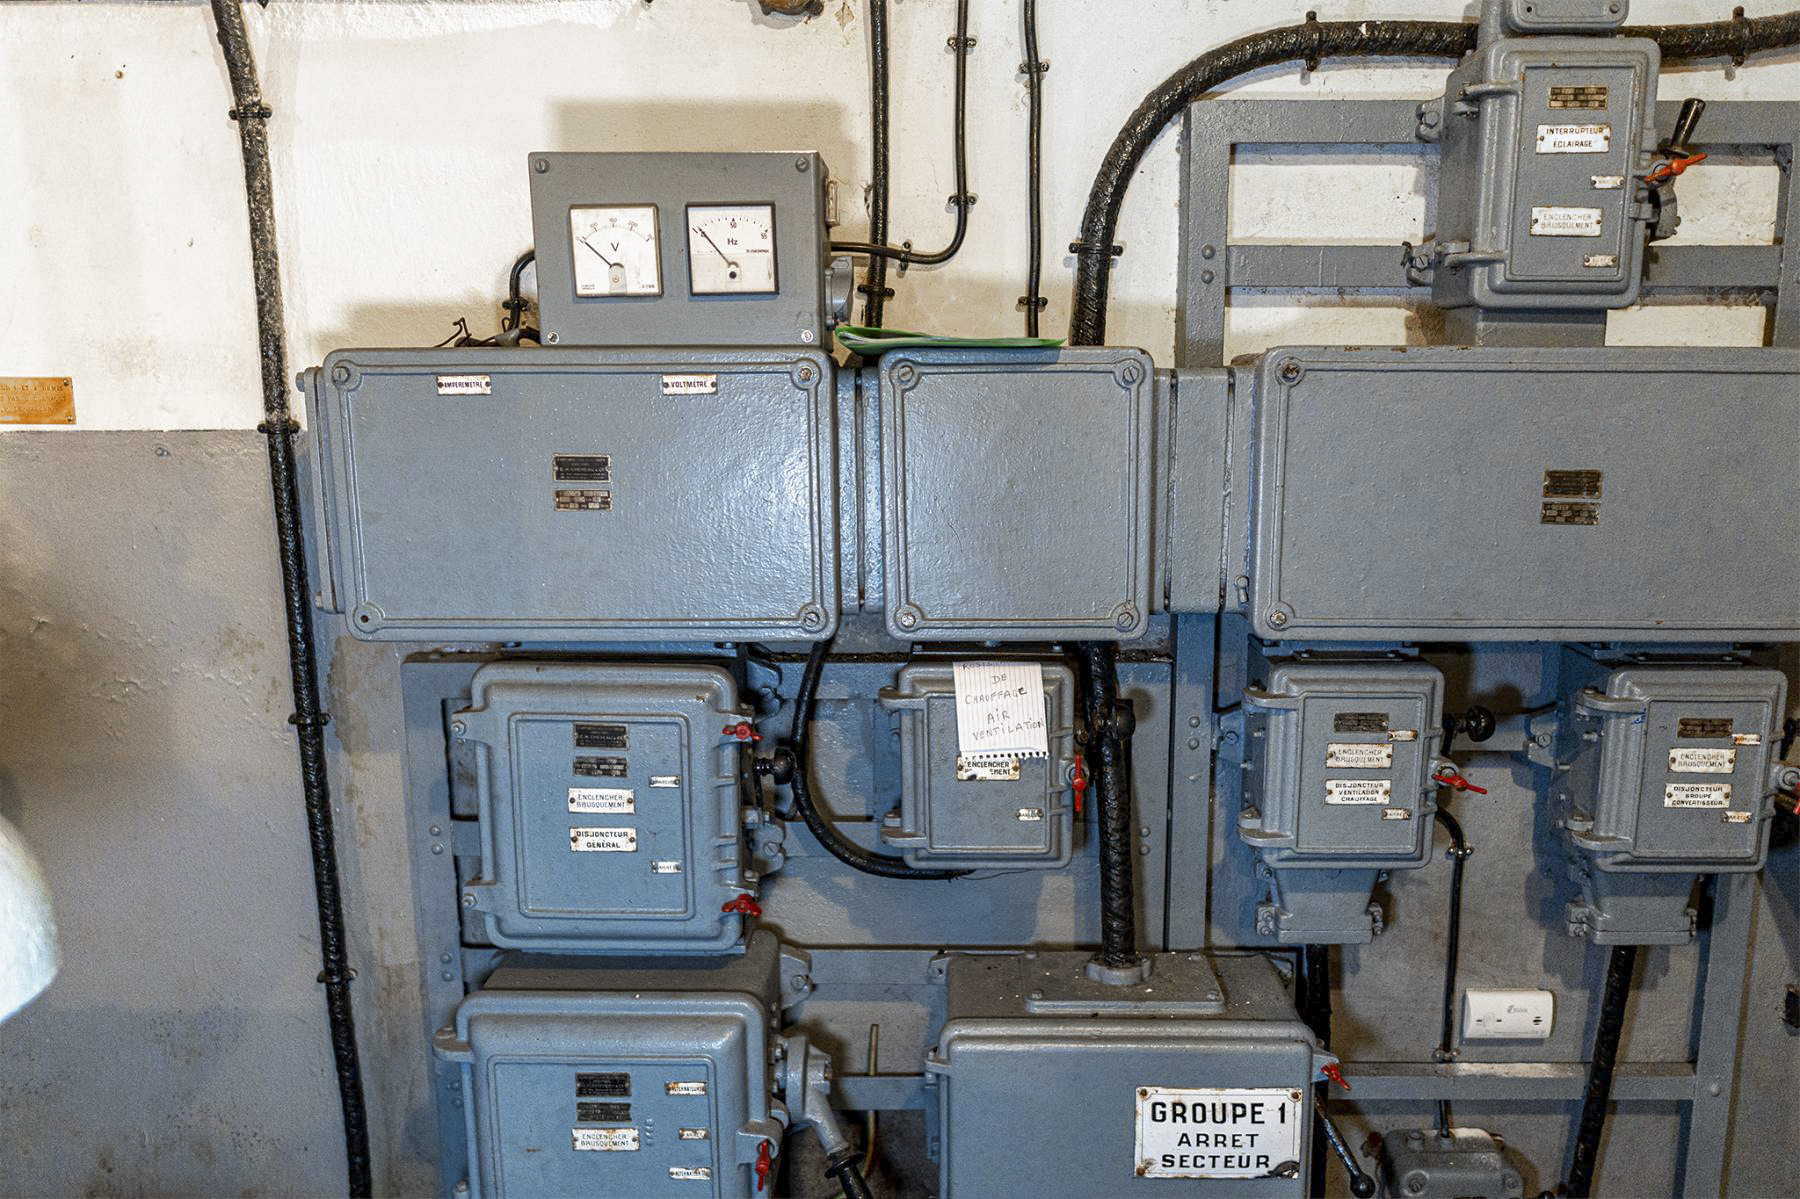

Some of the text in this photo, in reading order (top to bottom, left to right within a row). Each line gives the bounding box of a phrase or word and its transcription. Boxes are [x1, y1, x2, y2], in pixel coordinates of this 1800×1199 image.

[1546, 127, 1604, 135] INTERRUPTEUR
[1543, 213, 1592, 221] ENCLENCHER
[1541, 222, 1593, 230] BRUSQUEMENT
[610, 241, 620, 252] V
[727, 238, 738, 246] Hz
[991, 673, 1008, 684] DE
[965, 687, 1028, 705] CHAUFFAGE
[576, 801, 625, 809] BRUSQUEMENT
[576, 830, 629, 838] DISJONCTEUR
[1151, 1101, 1286, 1124] GROUPE 1
[1177, 1132, 1259, 1148] ARRET
[1161, 1154, 1270, 1169] SECTEUR
